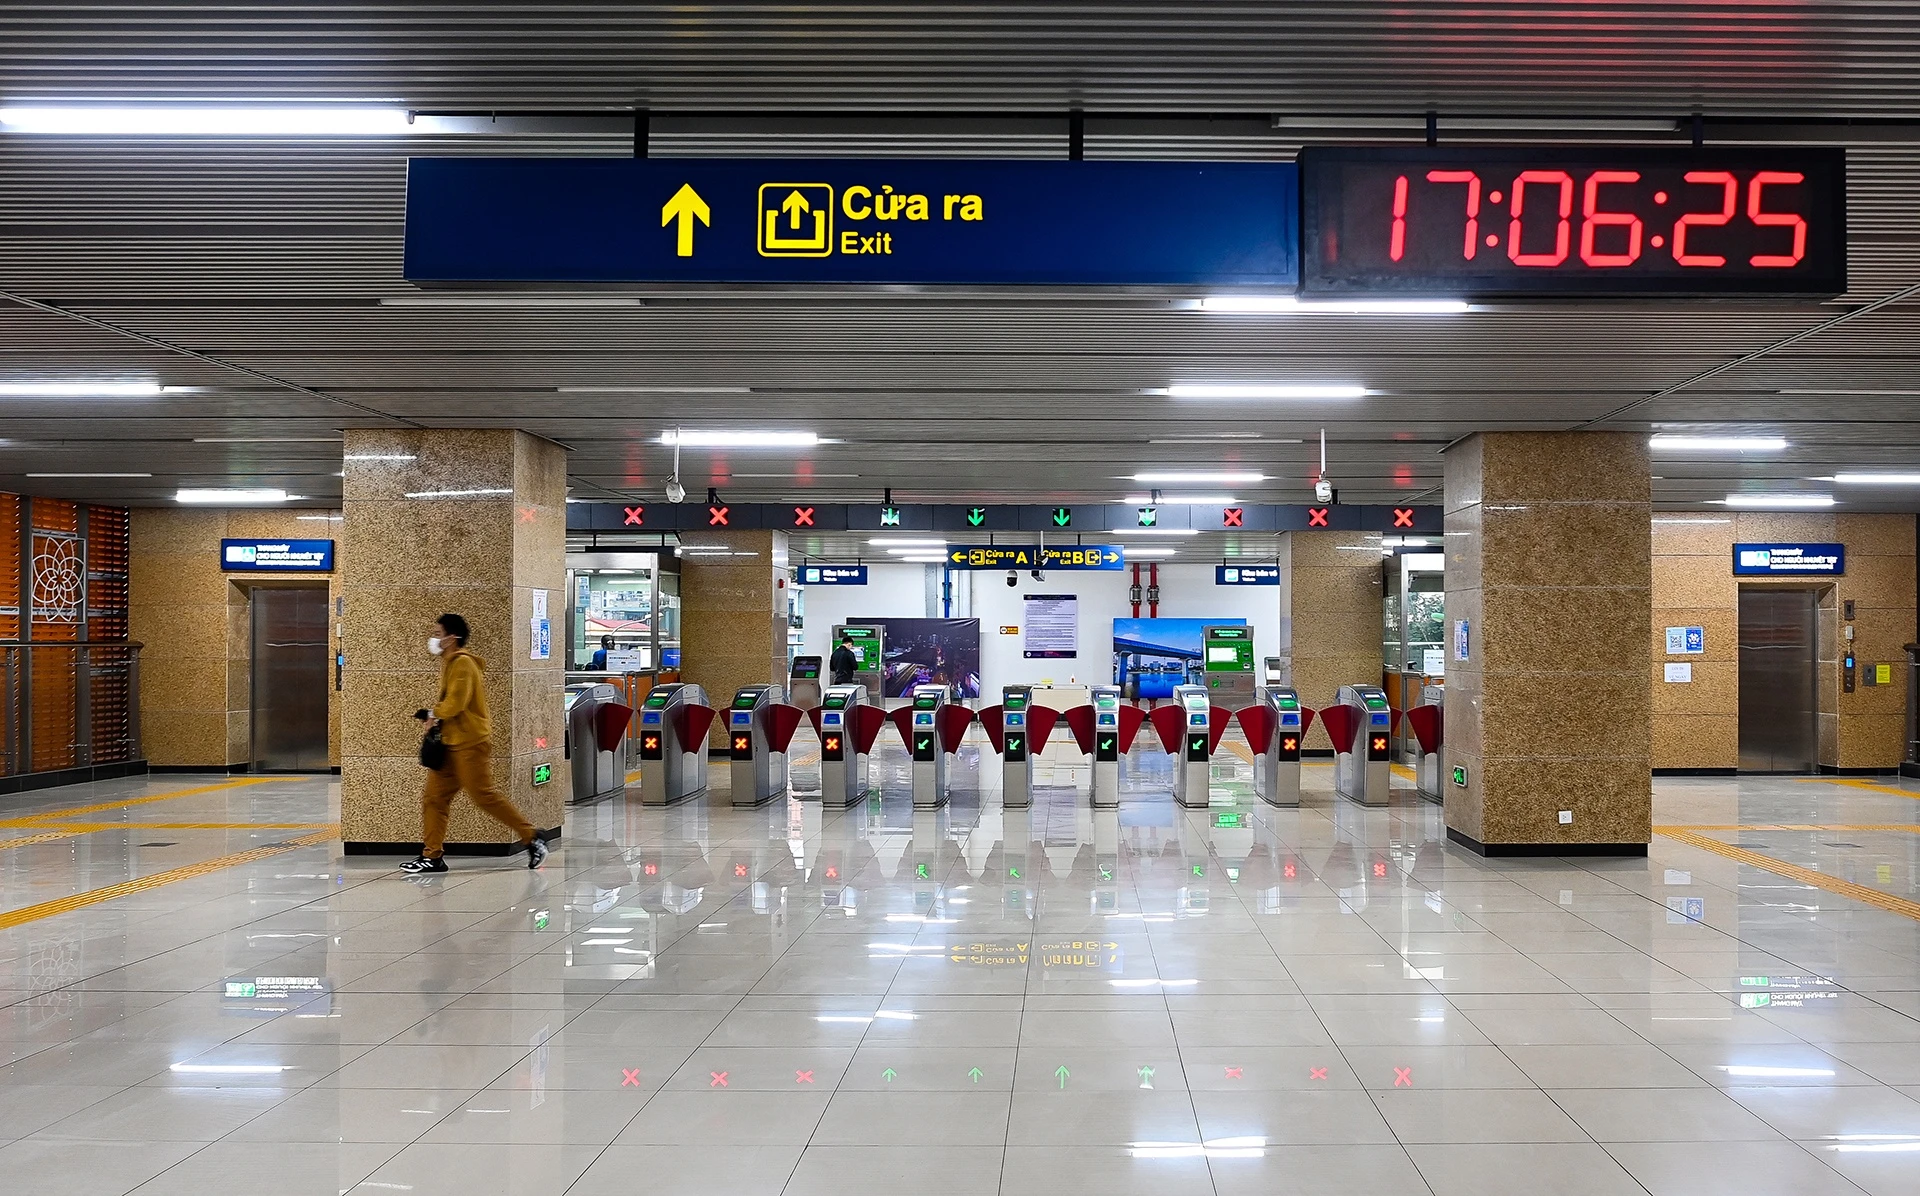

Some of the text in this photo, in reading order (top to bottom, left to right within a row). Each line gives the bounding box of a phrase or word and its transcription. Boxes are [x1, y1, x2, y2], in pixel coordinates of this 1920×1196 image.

[842, 184, 984, 221] Cửa ra
[1390, 170, 1807, 267] 17:06:25
[841, 231, 892, 255] Exit
[1016, 551, 1028, 564] A
[1072, 551, 1084, 564] B
